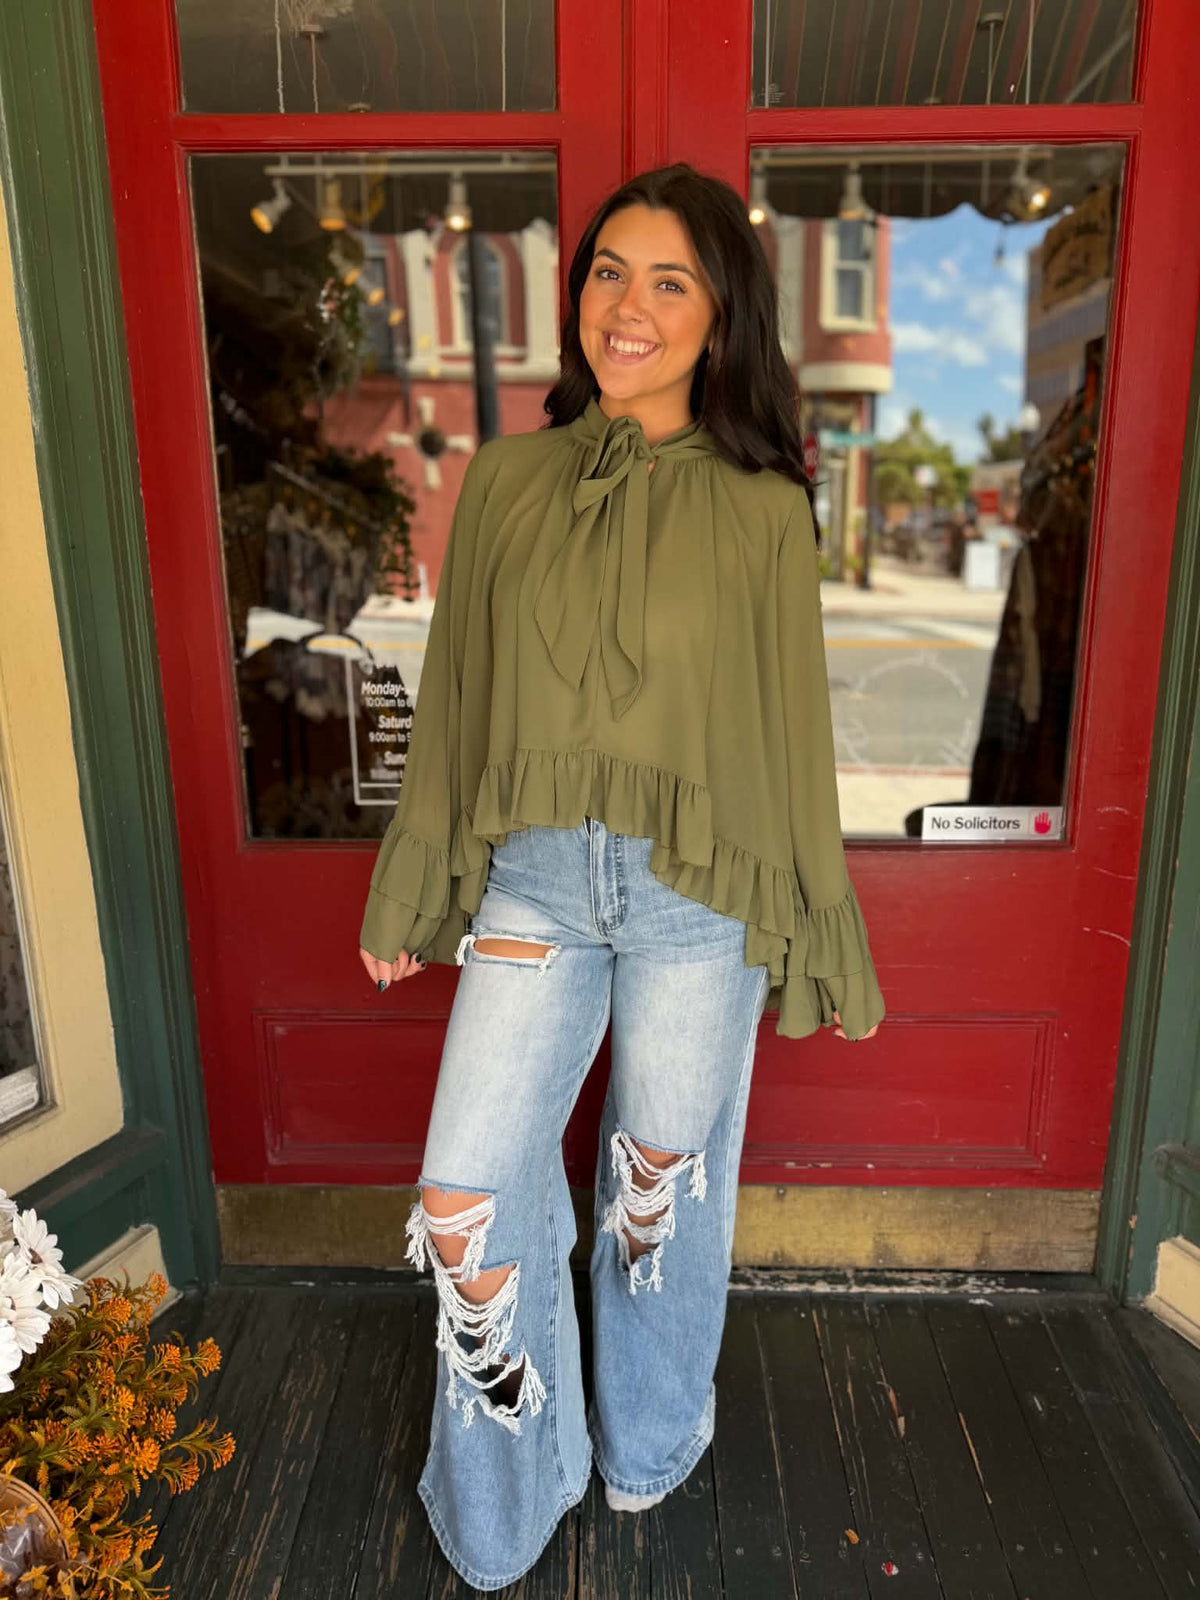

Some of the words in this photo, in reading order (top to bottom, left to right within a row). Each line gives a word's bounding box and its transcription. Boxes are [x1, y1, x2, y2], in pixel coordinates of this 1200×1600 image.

[361, 681, 406, 697] Monday-
[397, 698, 406, 707] to
[378, 715, 412, 729] Saturd
[369, 731, 396, 742] 9:00am
[397, 733, 406, 743] to
[931, 817, 950, 829] No
[954, 816, 1020, 830] Solicitors
